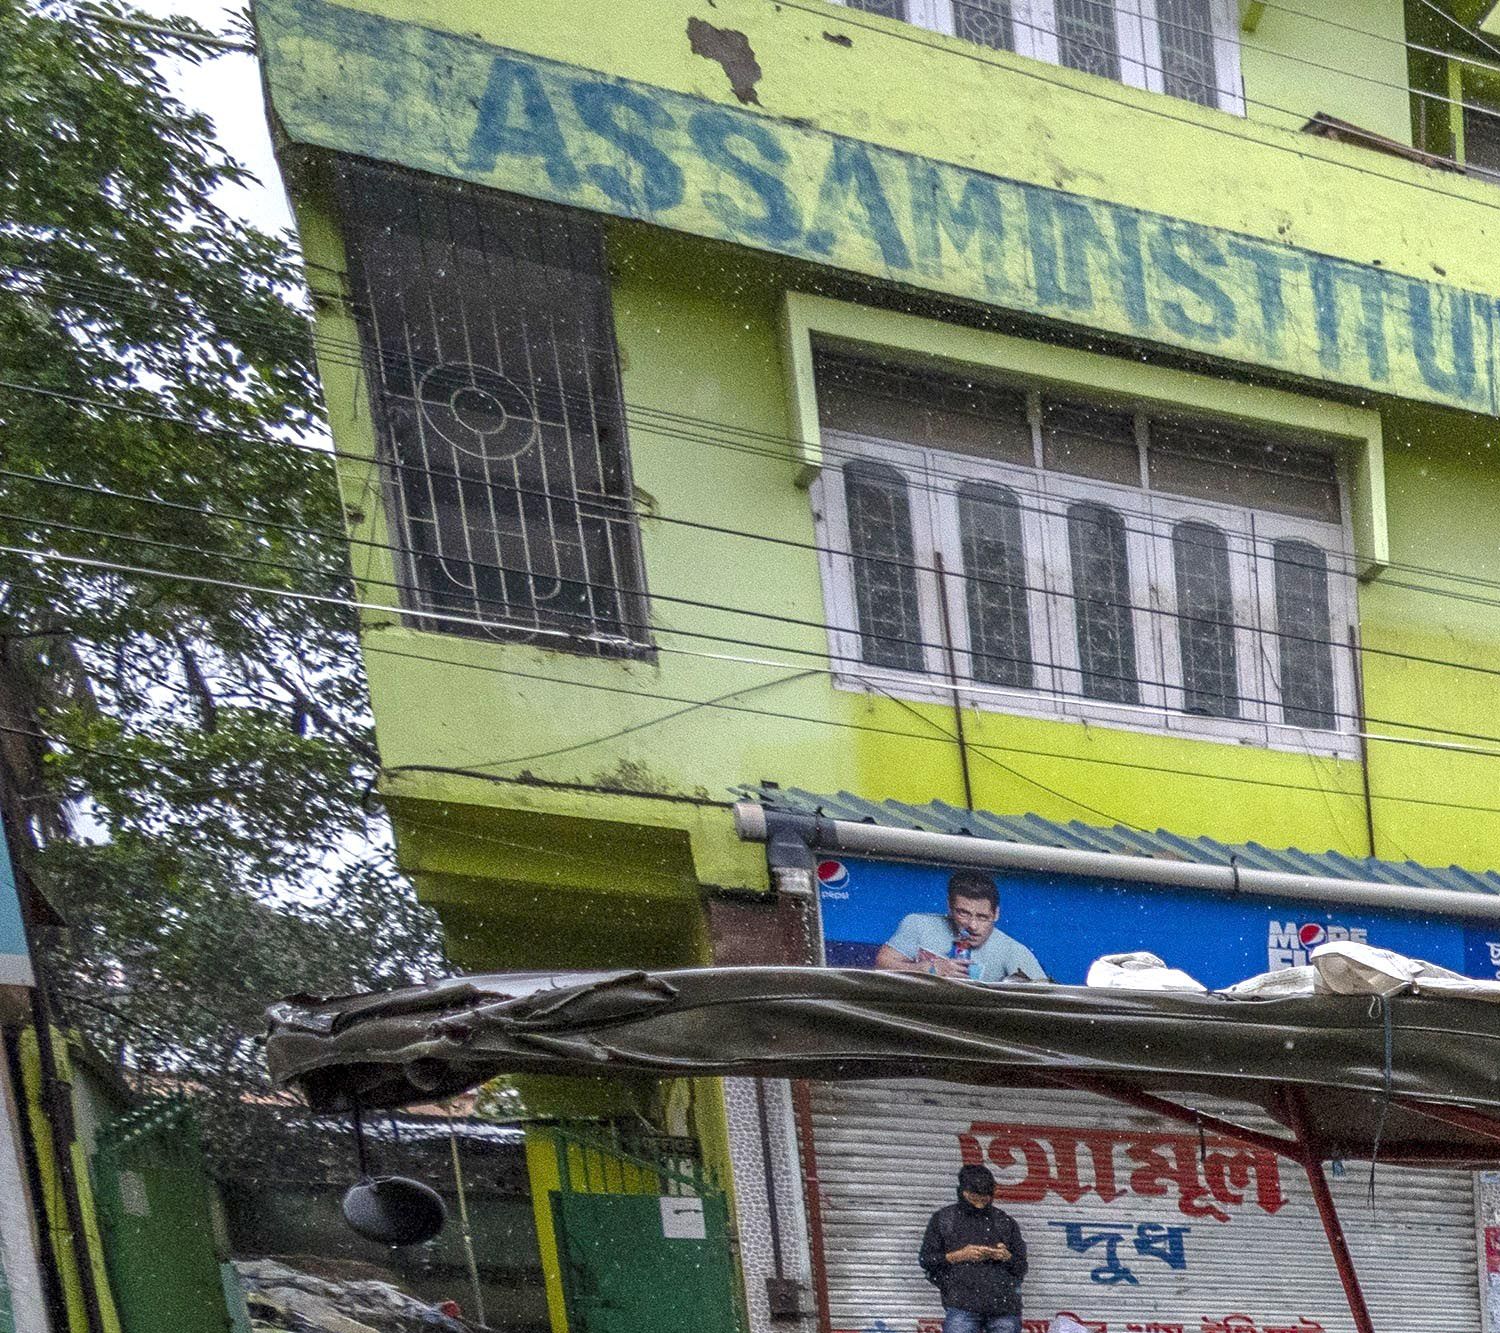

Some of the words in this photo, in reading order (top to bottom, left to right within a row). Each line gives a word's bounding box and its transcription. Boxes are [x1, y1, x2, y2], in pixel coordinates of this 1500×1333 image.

[462, 58, 1004, 296] ASSAM
[958, 1121, 1290, 1224] আমূল
[1048, 1221, 1191, 1285] দুধ
